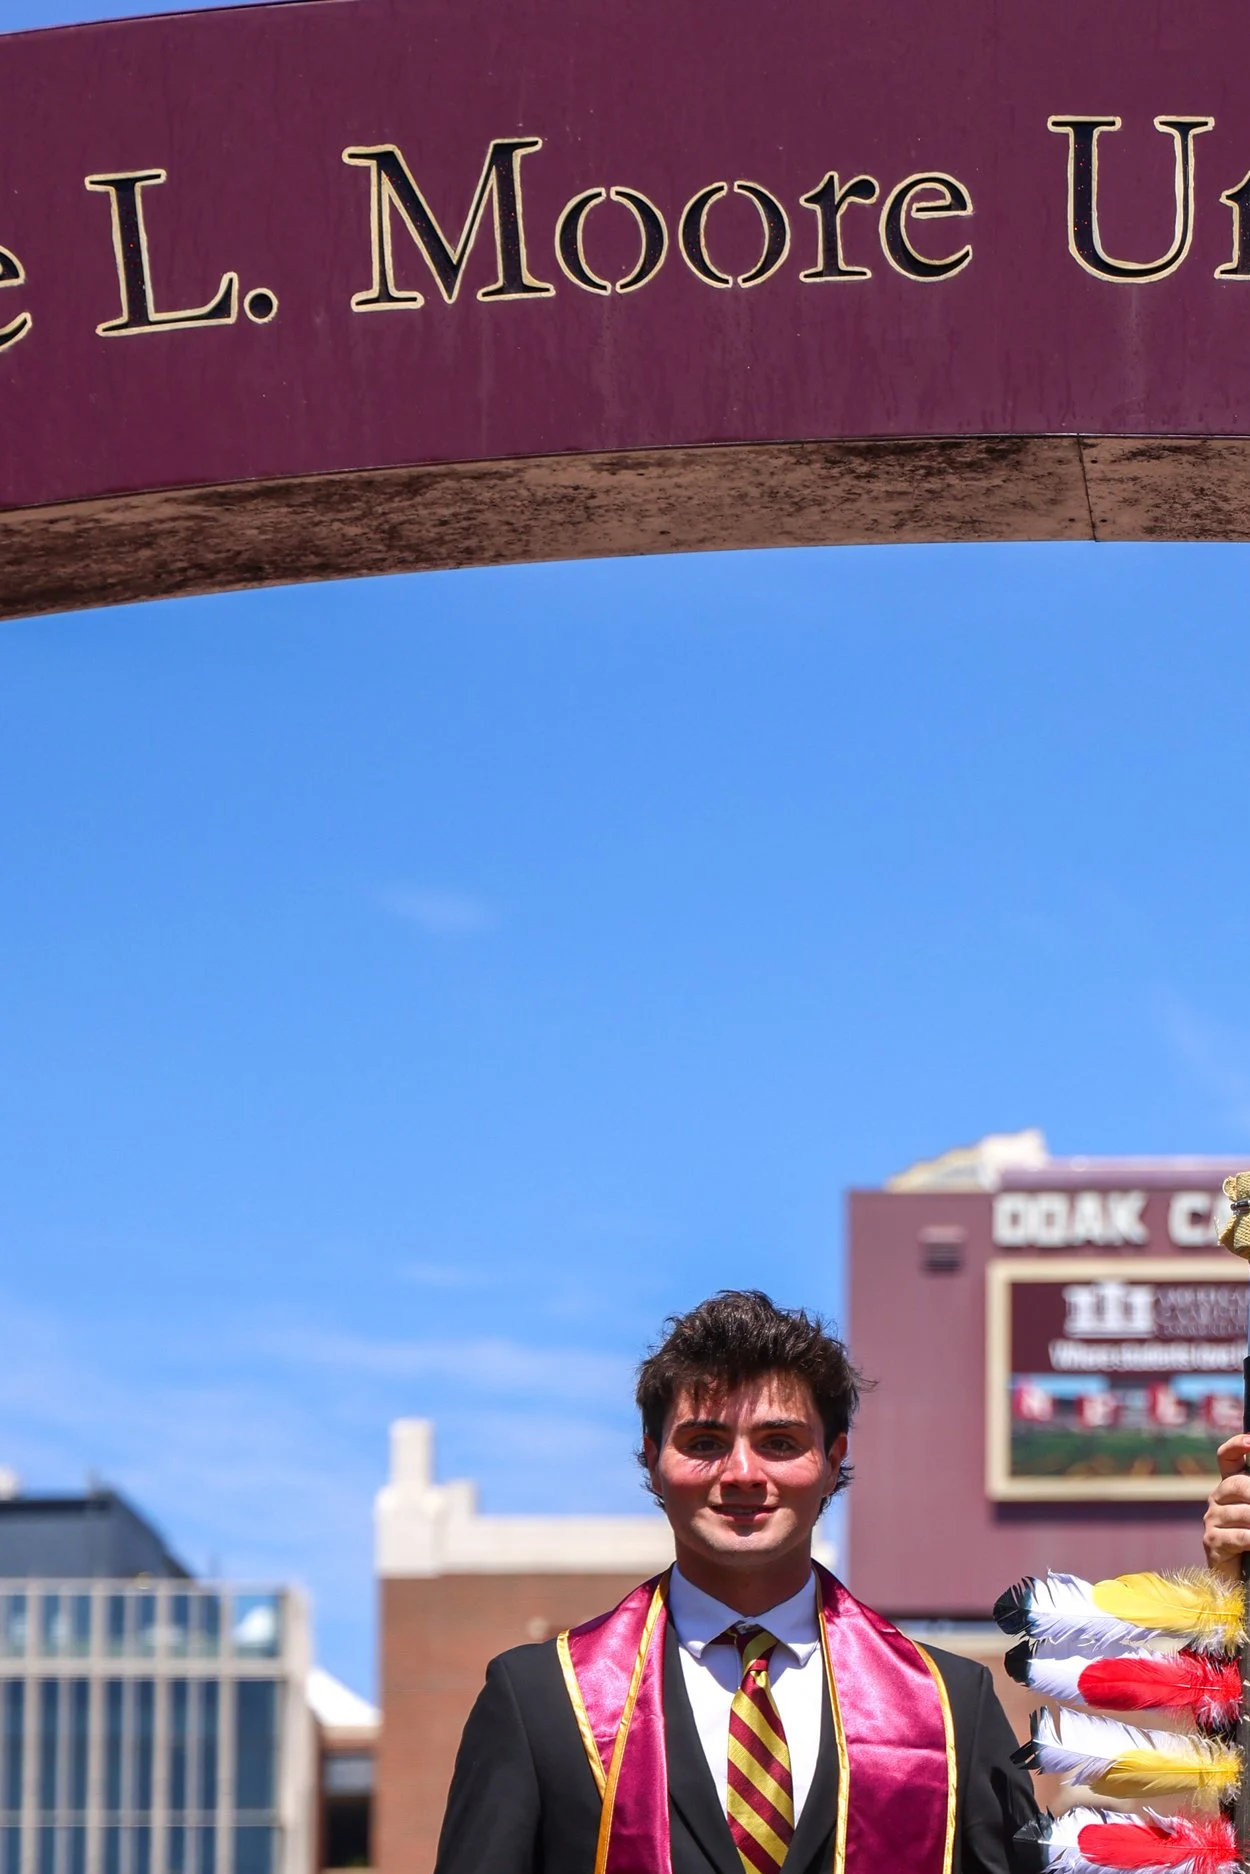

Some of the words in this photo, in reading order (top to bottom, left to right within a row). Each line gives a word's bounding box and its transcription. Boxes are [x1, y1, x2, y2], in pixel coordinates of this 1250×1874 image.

[84, 167, 280, 339] L.
[342, 136, 975, 313] Moore
[992, 1190, 1148, 1246] DOAK
